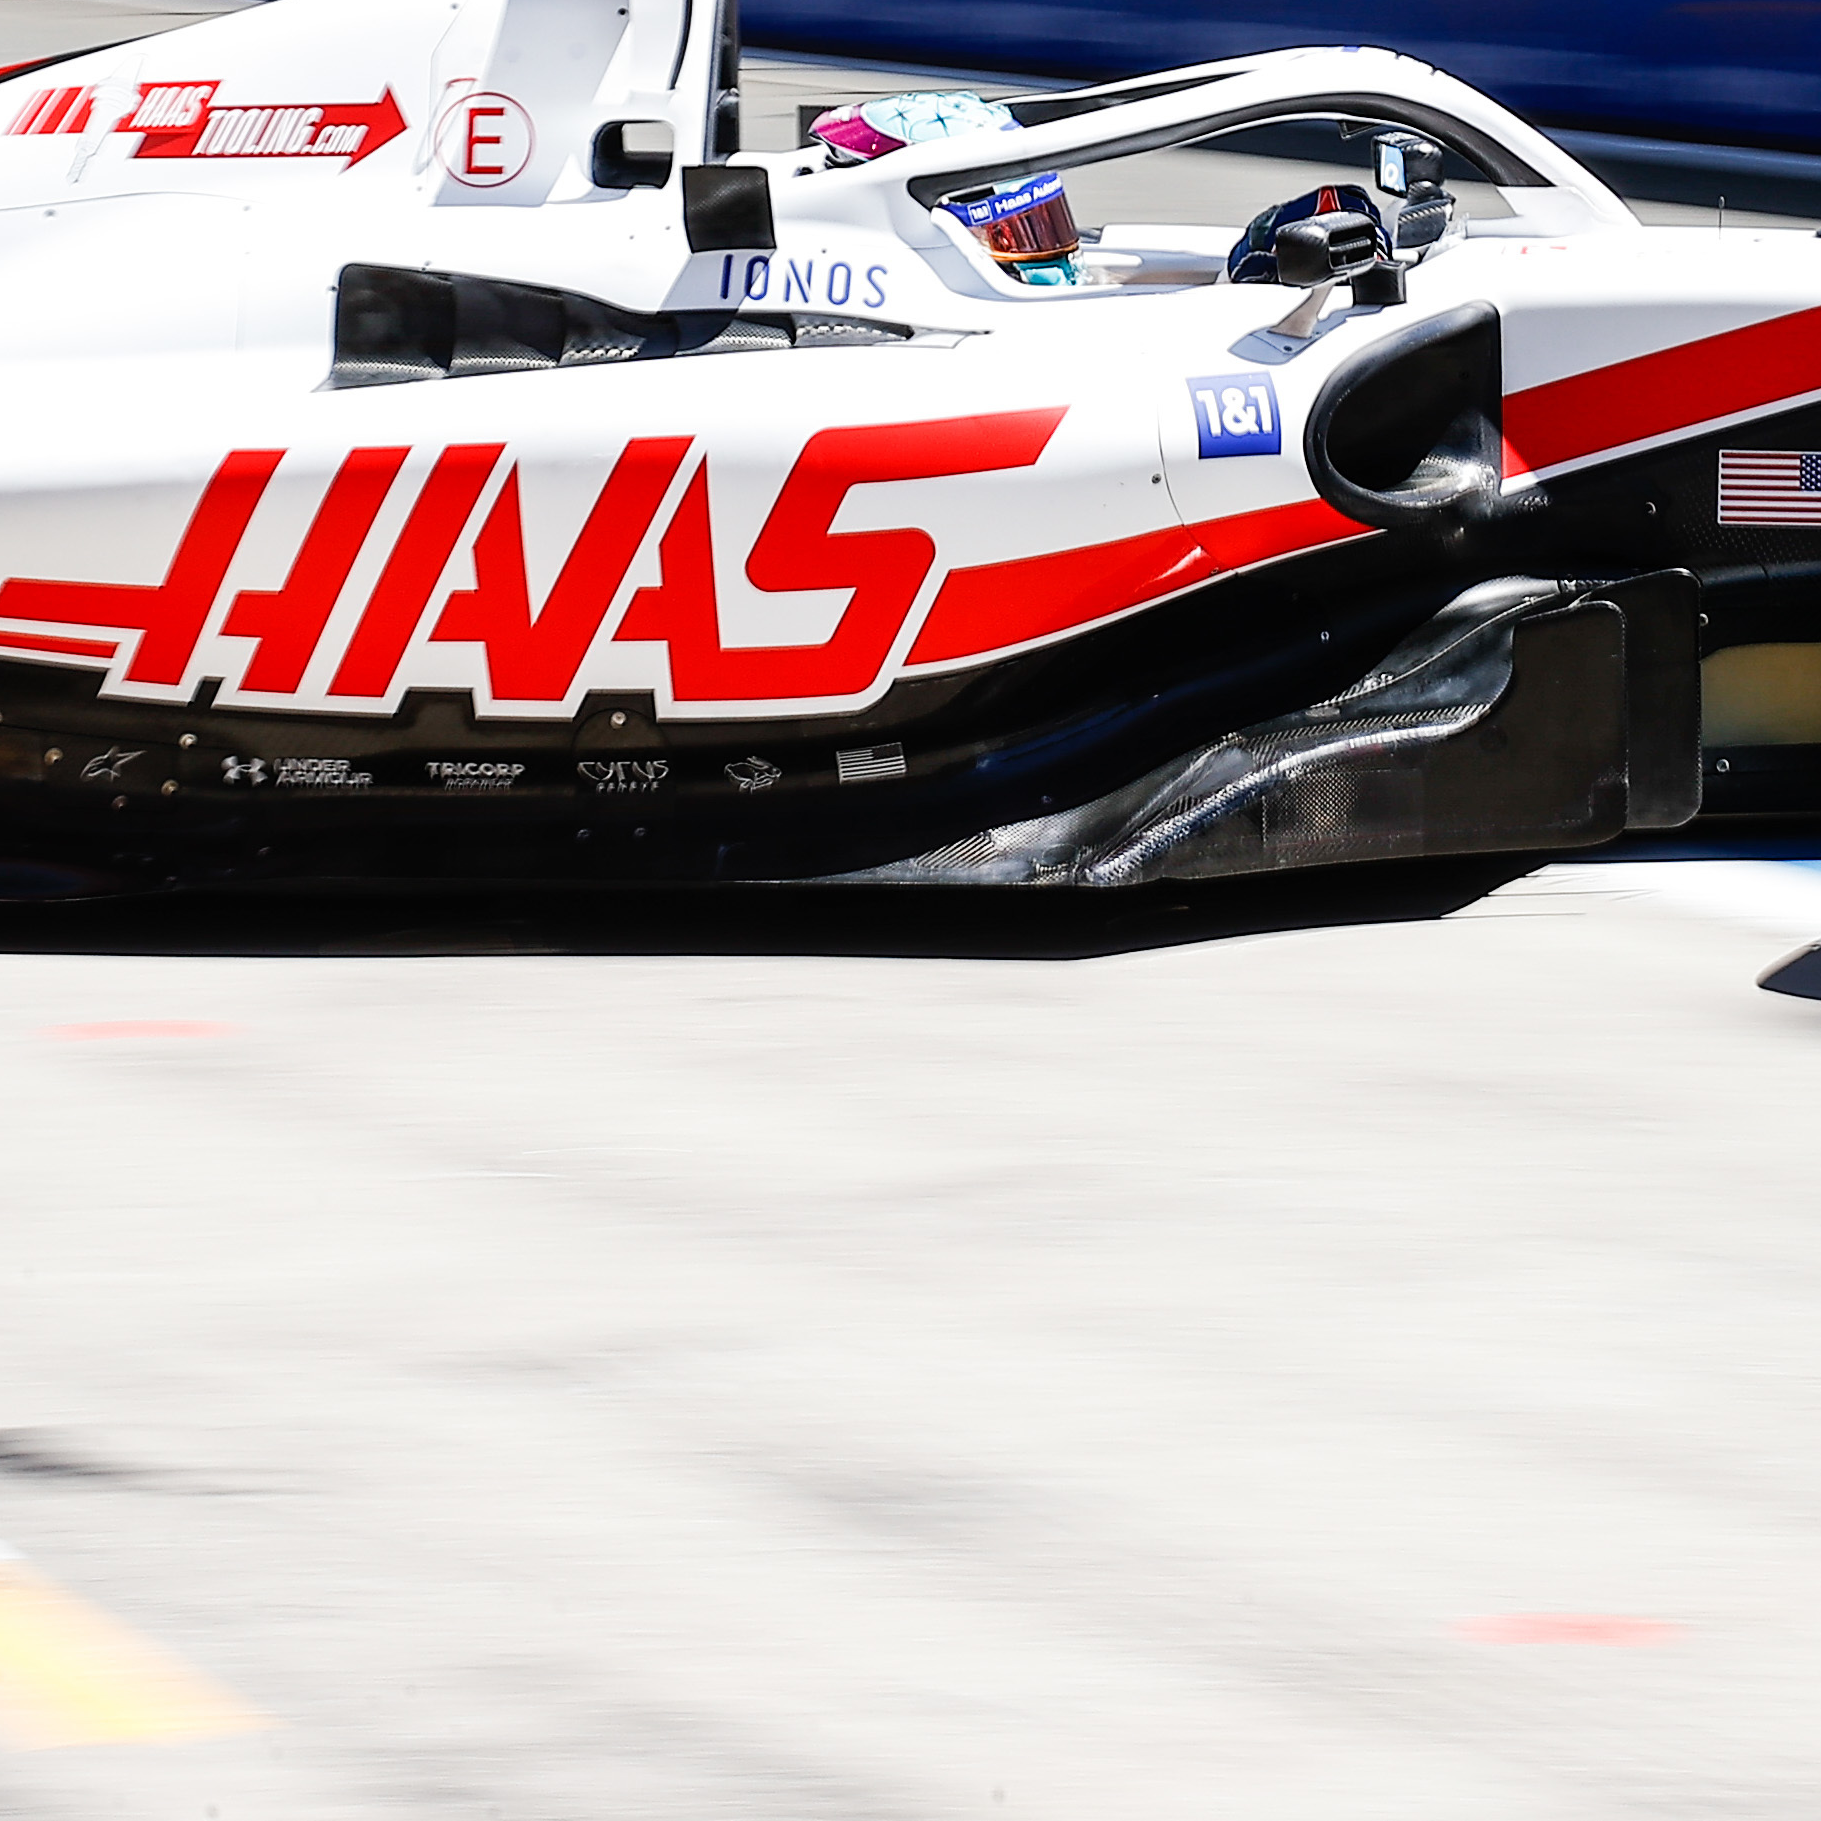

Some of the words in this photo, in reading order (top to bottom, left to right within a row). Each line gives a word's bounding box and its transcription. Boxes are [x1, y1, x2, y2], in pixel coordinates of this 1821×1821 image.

[128, 85, 214, 128] HAAS
[465, 107, 505, 174] E
[994, 192, 1032, 214] Haas
[720, 254, 888, 309] IONOS
[1195, 385, 1273, 437] 1&1
[273, 758, 351, 772] UNDER
[425, 762, 526, 778] TRICORP
